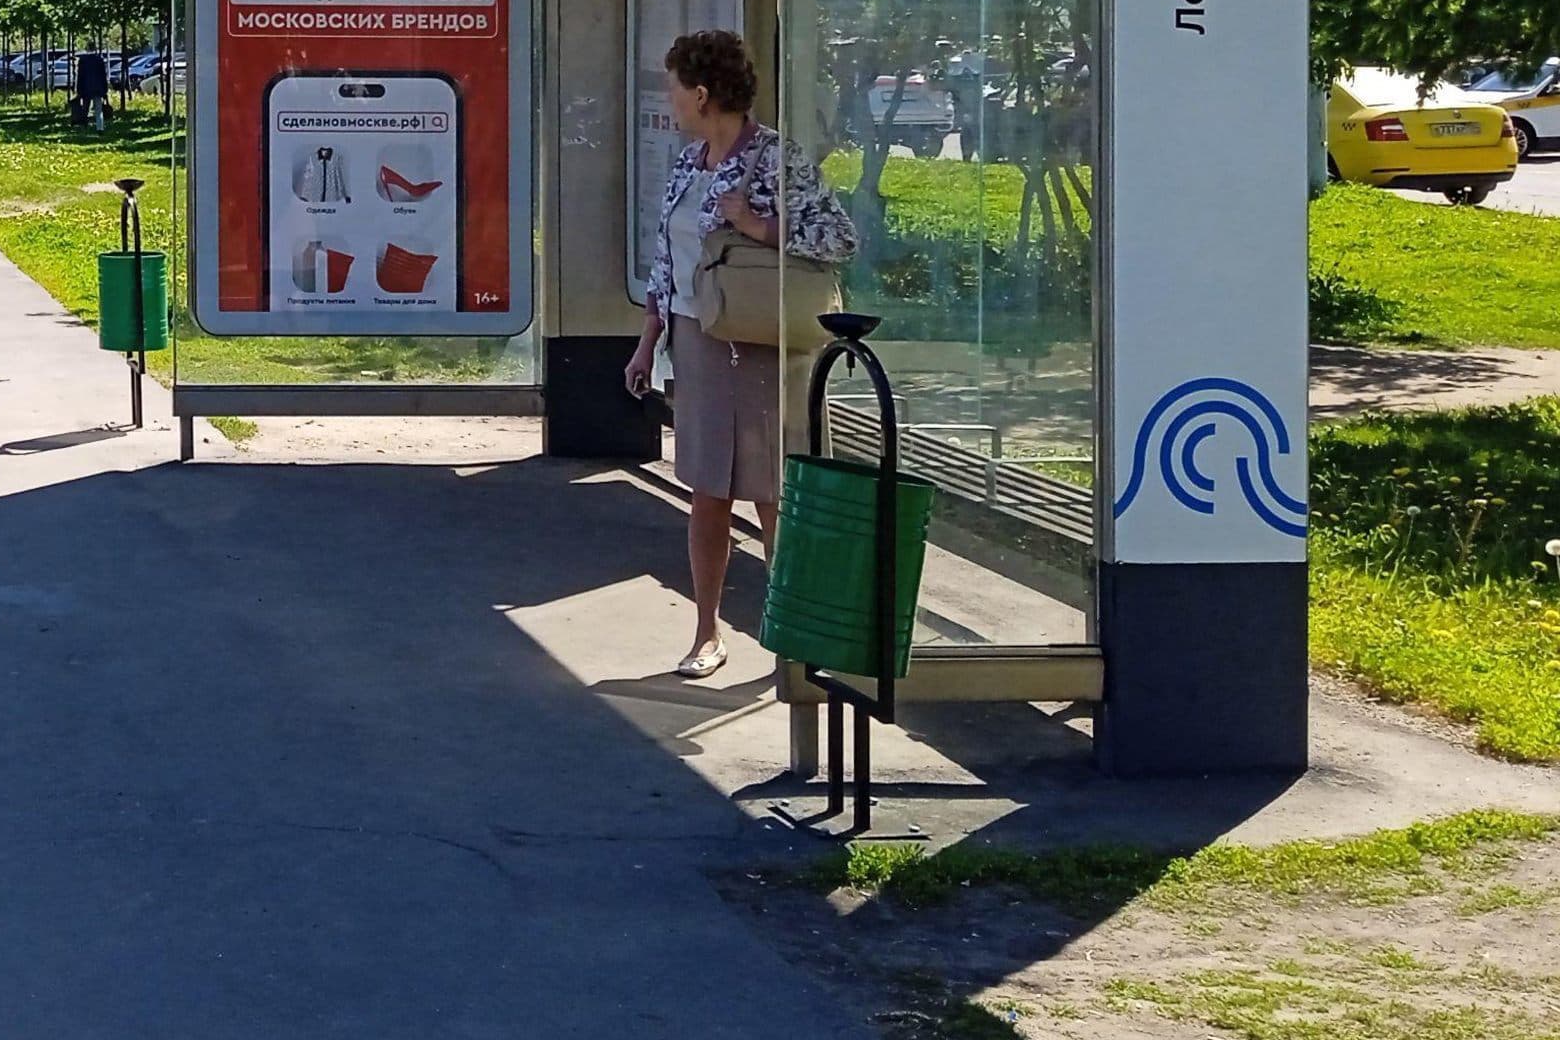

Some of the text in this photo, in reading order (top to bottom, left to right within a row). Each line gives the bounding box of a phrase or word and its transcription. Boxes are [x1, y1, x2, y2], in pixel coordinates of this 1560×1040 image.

[238, 12, 488, 32] МОСКОВСКИХ БРЕНДОВ
[282, 114, 422, 131] сделановмоскве.рф
[474, 292, 500, 305] 16+
